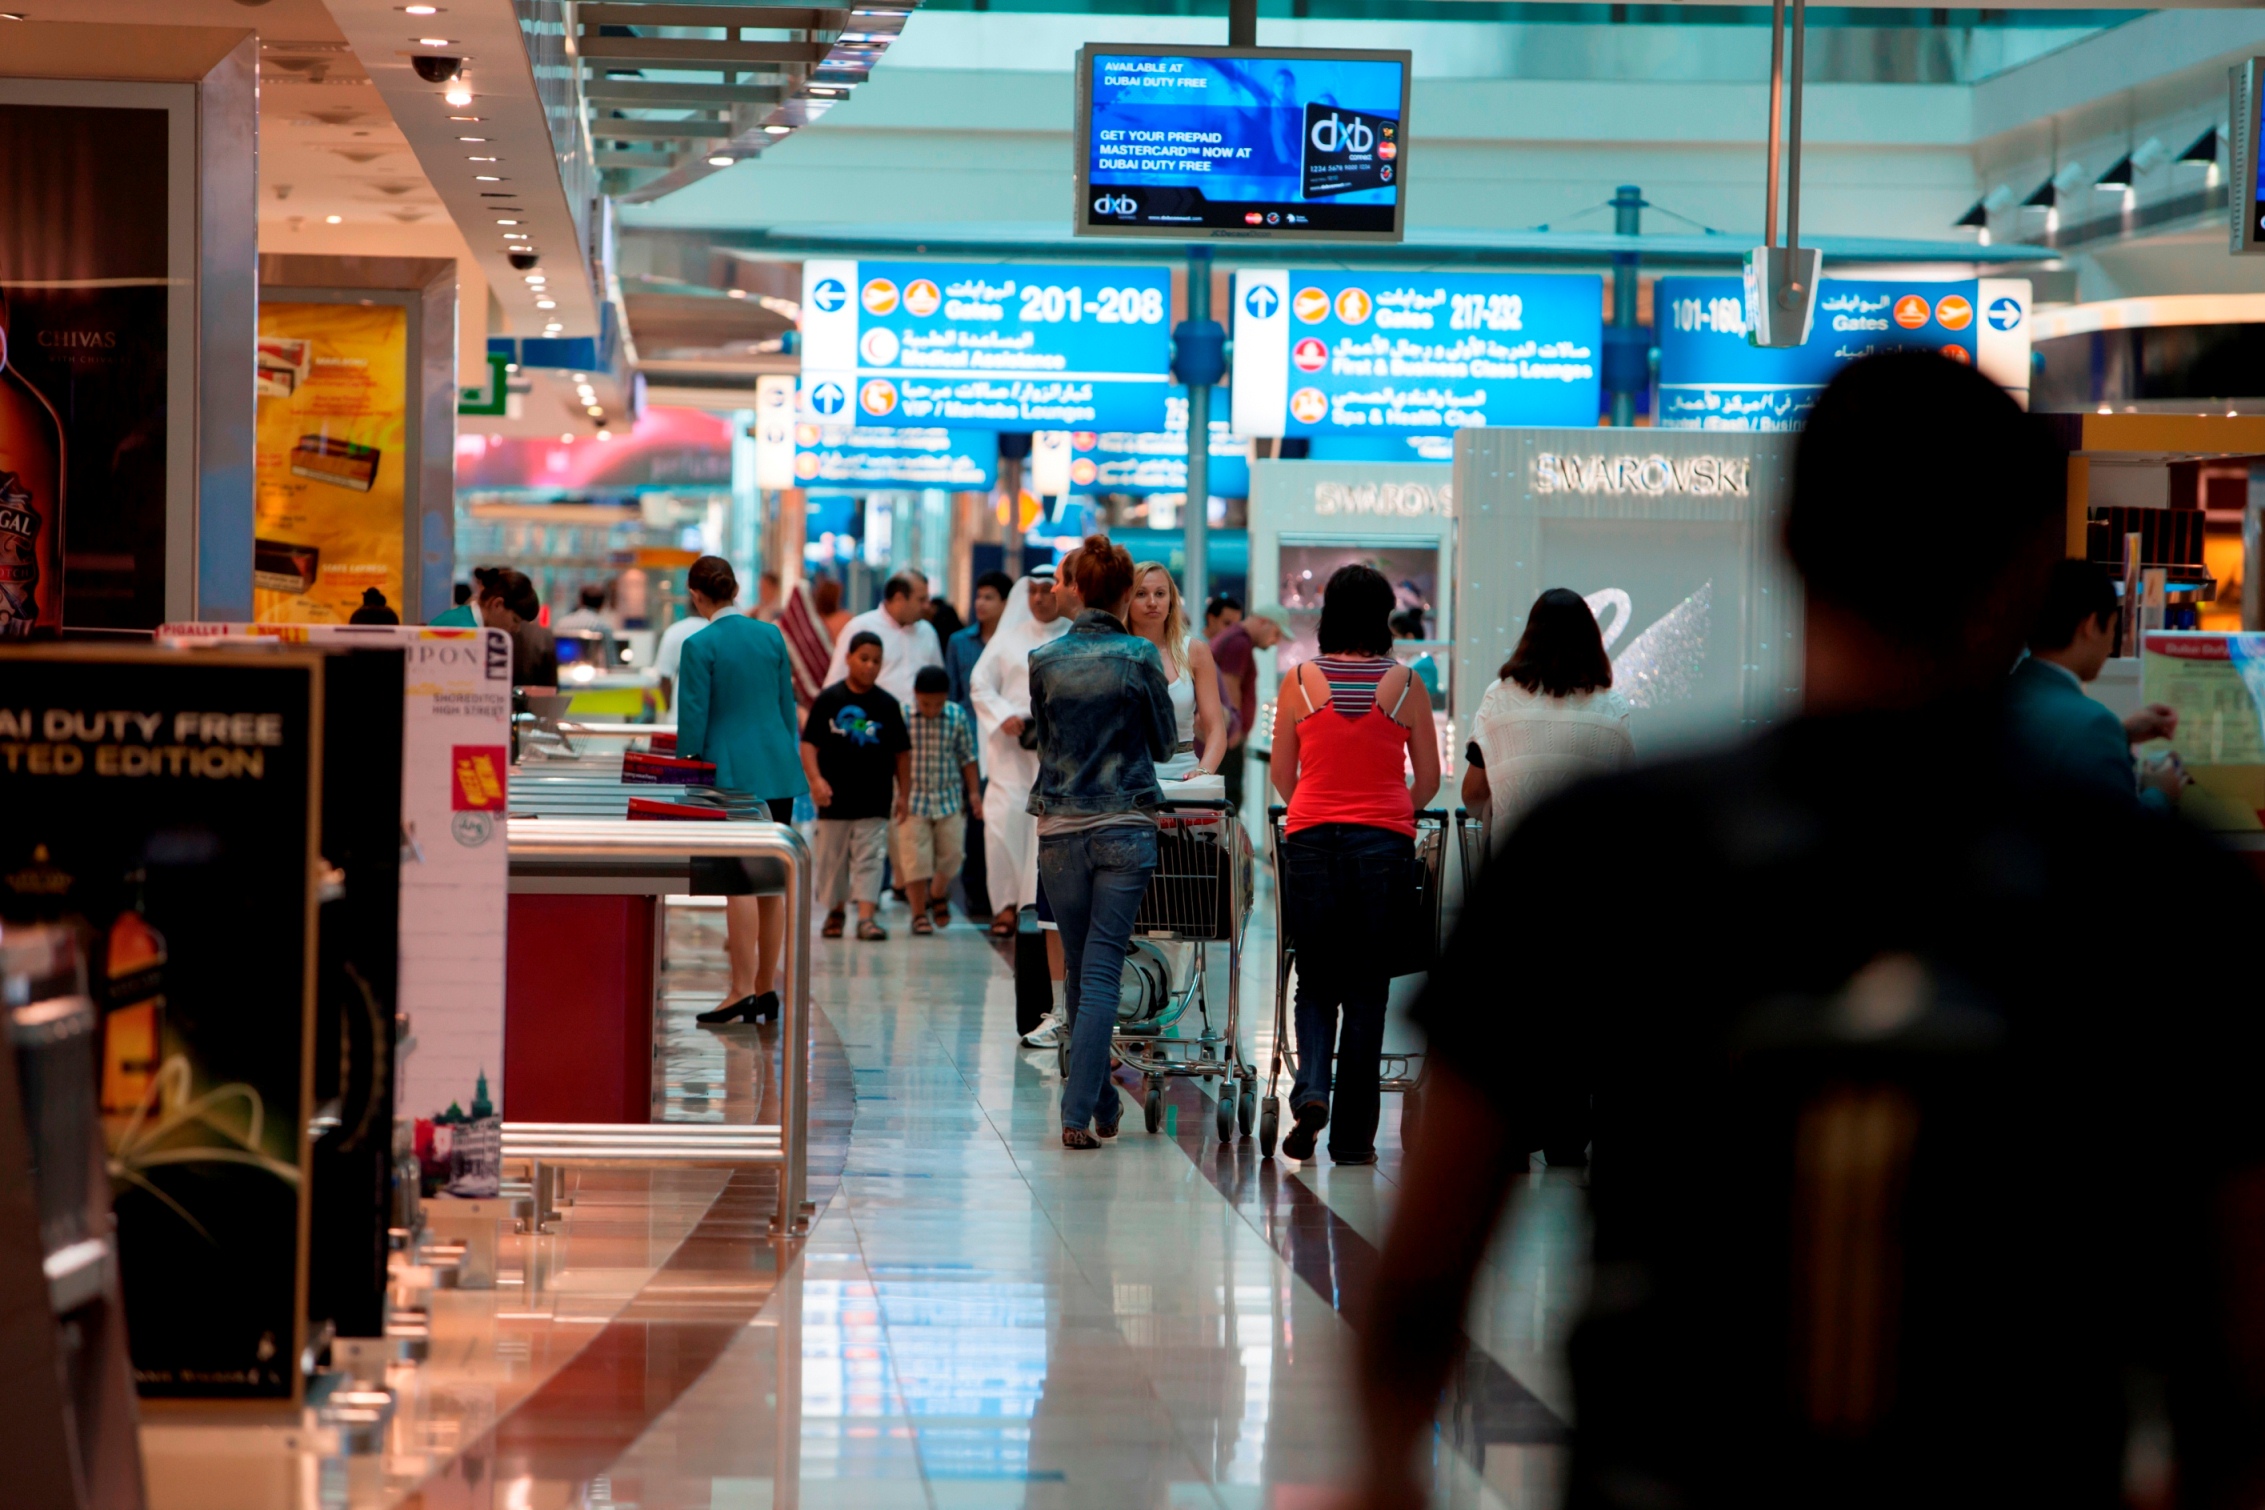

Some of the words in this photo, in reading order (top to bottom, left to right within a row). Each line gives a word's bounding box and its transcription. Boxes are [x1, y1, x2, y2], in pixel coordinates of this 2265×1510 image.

[1104, 62, 1167, 73] AVAILABLE
[1168, 63, 1184, 73] AT
[1104, 76, 1141, 86] DUBAI
[1142, 77, 1176, 87] DUTY
[1176, 78, 1207, 88] FREE
[1100, 130, 1126, 141] GET
[1128, 130, 1165, 142] YOUR
[1167, 131, 1222, 143] PREPAID
[1310, 112, 1374, 153] dxb
[1201, 146, 1234, 158] NOW
[1235, 147, 1253, 158] AT
[1099, 158, 1139, 170] DUBAI
[1140, 159, 1176, 171] DUTY
[1178, 160, 1212, 172] FREE
[1093, 194, 1138, 215] dxb
[944, 299, 1004, 321] Gates
[1019, 285, 1164, 324] 201-208
[1374, 307, 1434, 330] Gates
[1832, 314, 1889, 332] Gates
[37, 330, 117, 348] CHIVAS
[1332, 357, 1373, 377] First
[1373, 358, 1389, 377] &
[1331, 407, 1367, 427] Spa
[1368, 408, 1384, 426] &
[1536, 452, 1751, 497] SWAROVSKI
[433, 693, 504, 704] SHOREDITCH
[432, 704, 460, 716] HIGH
[463, 704, 504, 717] STREET
[43, 708, 162, 742] DUTY
[173, 711, 284, 746] FREE
[95, 744, 264, 779] EDITION
